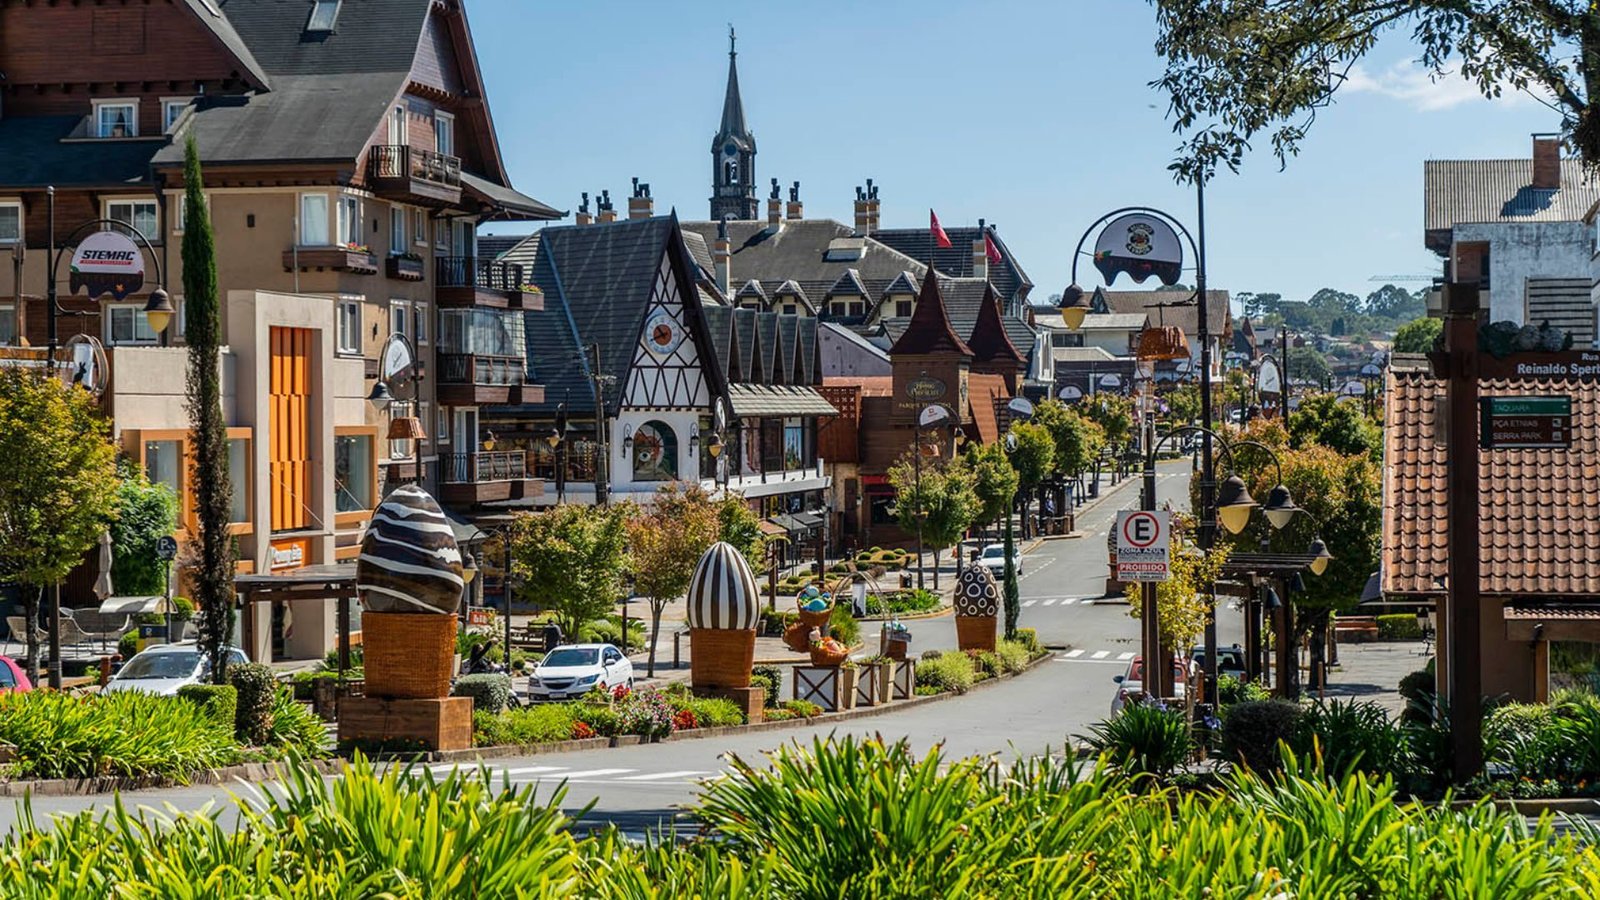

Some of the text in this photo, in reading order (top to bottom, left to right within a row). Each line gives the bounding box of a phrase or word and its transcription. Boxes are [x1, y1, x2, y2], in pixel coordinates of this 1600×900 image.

[82, 250, 135, 260] STEMAC
[1518, 363, 1567, 374] Reinaldo
[1510, 419, 1538, 427] ETNIAS
[1493, 432, 1519, 440] SERRA
[1135, 519, 1150, 540] E
[1120, 563, 1164, 571] PROIBIDO
